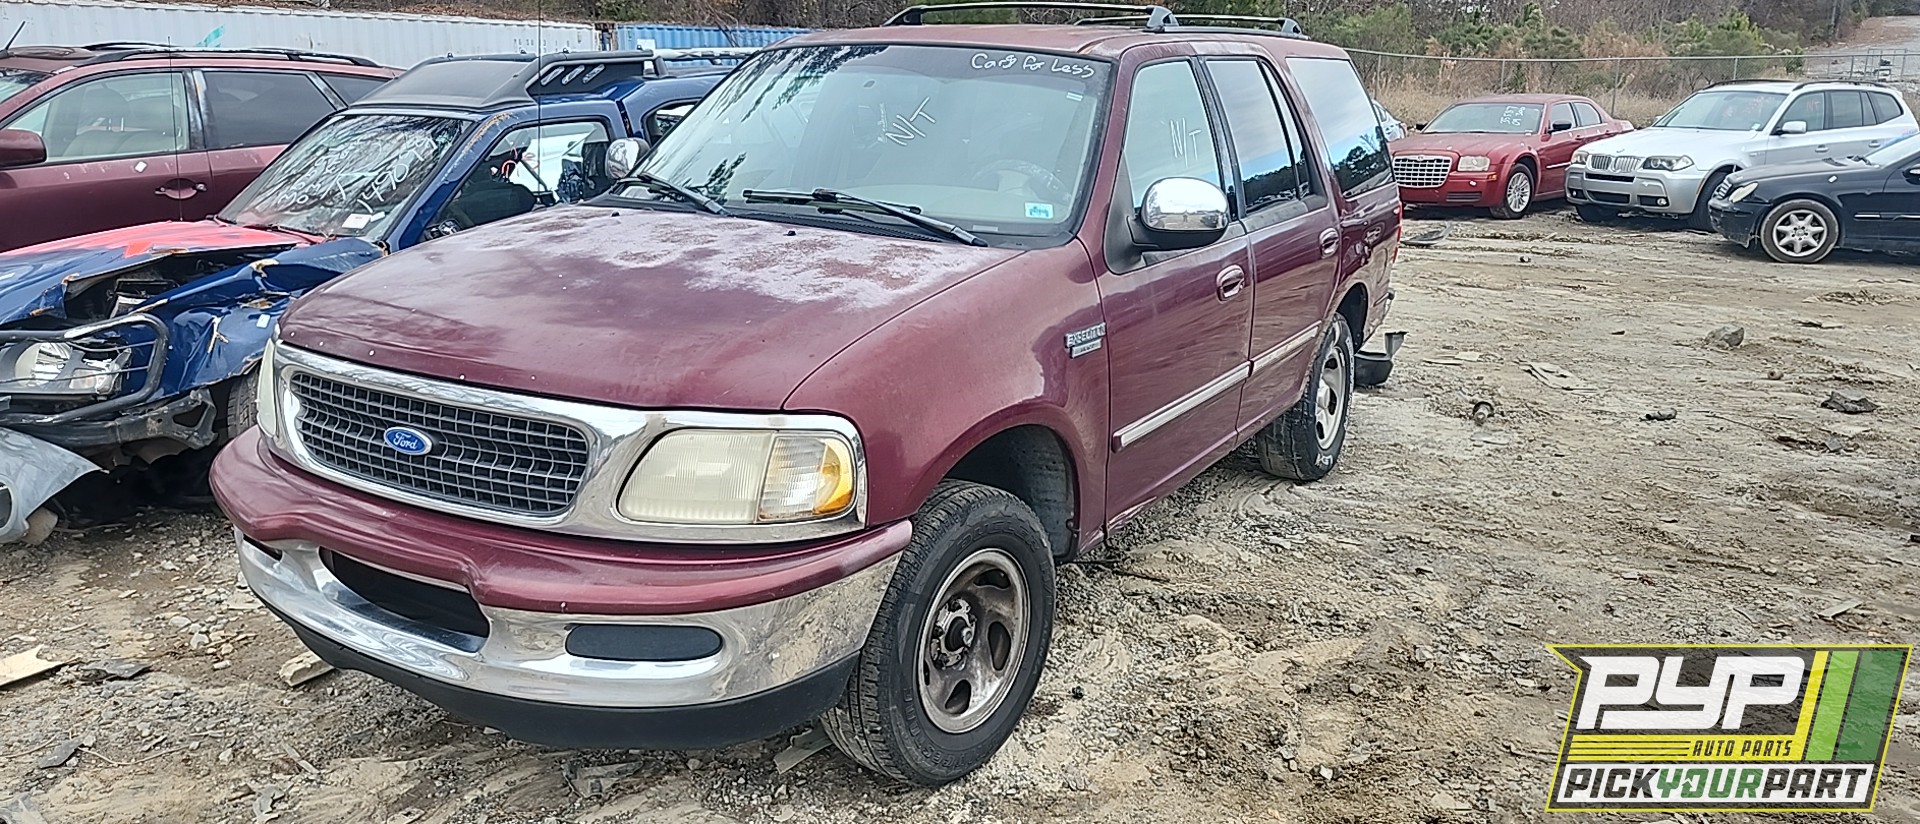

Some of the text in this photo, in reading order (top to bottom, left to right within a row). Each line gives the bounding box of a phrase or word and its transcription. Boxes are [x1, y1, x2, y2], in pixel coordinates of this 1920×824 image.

[1051, 58, 1095, 78] Less
[885, 96, 936, 146] N/T
[1169, 117, 1202, 168] N/T
[392, 431, 418, 450] Ford
